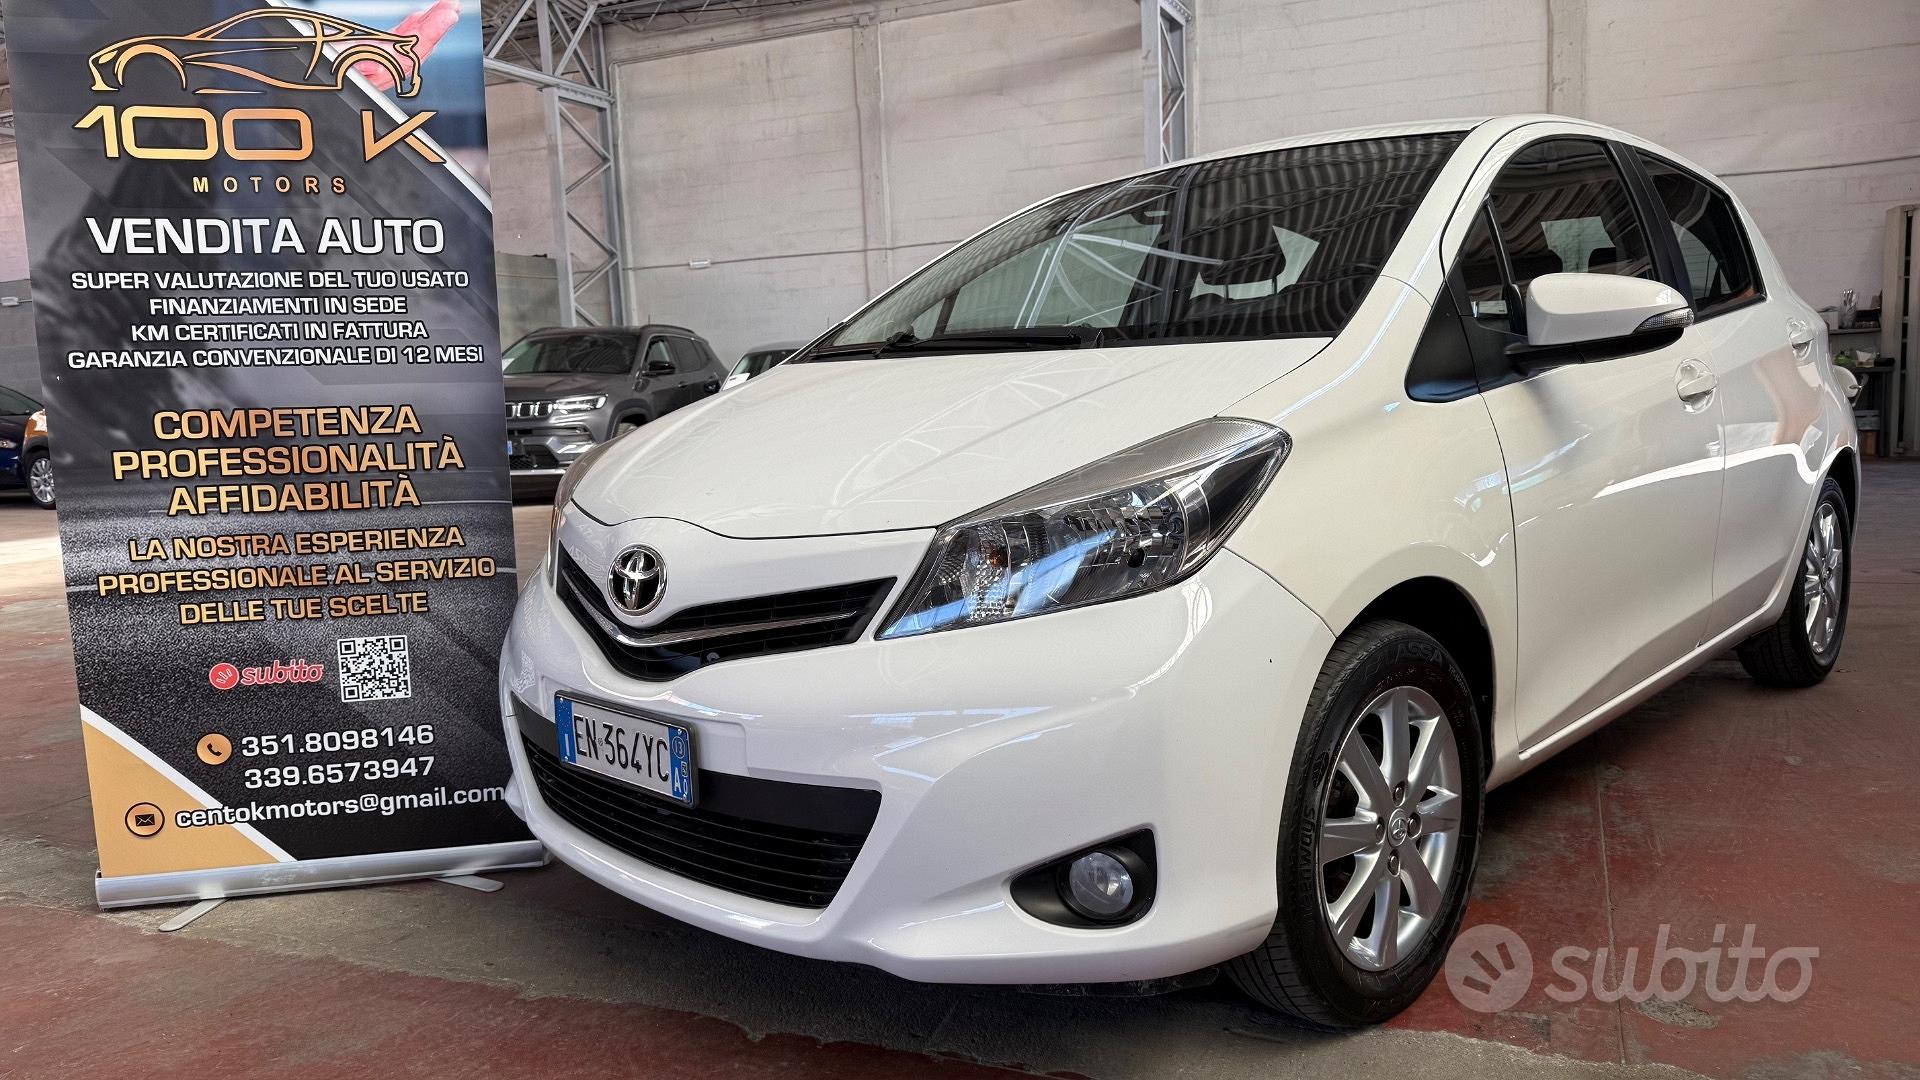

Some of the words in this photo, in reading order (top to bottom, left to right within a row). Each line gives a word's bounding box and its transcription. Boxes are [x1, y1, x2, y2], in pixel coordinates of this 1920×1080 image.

[73, 105, 313, 161] 100
[362, 110, 446, 163] K
[193, 177, 344, 192] MOTORS
[86, 218, 305, 253] VENDITA
[318, 219, 443, 253] AUTO
[72, 273, 149, 288] SUPER
[154, 272, 303, 288] VALUTAZIONE
[309, 272, 349, 287] DEL
[353, 272, 396, 287] TUO
[402, 272, 468, 287] USATO
[150, 298, 319, 316] FINANZIAMENTI
[325, 298, 346, 313] IN
[353, 297, 406, 312] SEDE
[132, 325, 168, 341] KM
[176, 324, 299, 341] CERTIFICATI
[305, 323, 326, 338] IN
[333, 322, 427, 339] FATTURA
[69, 351, 187, 368] GARANZIA
[193, 348, 370, 368] CONVENZIONALE
[376, 348, 396, 362] DI
[403, 346, 429, 362] 12
[436, 347, 482, 361] MESI
[154, 406, 420, 439] COMPETENZA
[113, 434, 464, 479] PROFESSIONALITÀ
[169, 474, 420, 515] AFFIDABILITÀ
[129, 540, 167, 561] LA
[175, 535, 288, 558] NOSTRA
[296, 528, 463, 553] ESPERIENZA
[99, 565, 328, 595] PROFESSIONALE
[335, 565, 370, 585] AL
[377, 558, 495, 581] SERVIZIO
[181, 601, 265, 624] DELLE
[270, 598, 322, 619] TUE
[329, 592, 428, 617] SCELTE
[242, 659, 324, 685] subito
[242, 725, 433, 756] 351.8098146
[245, 757, 435, 789] 339.6573947
[175, 786, 505, 828] centokmotors@gmail.com
